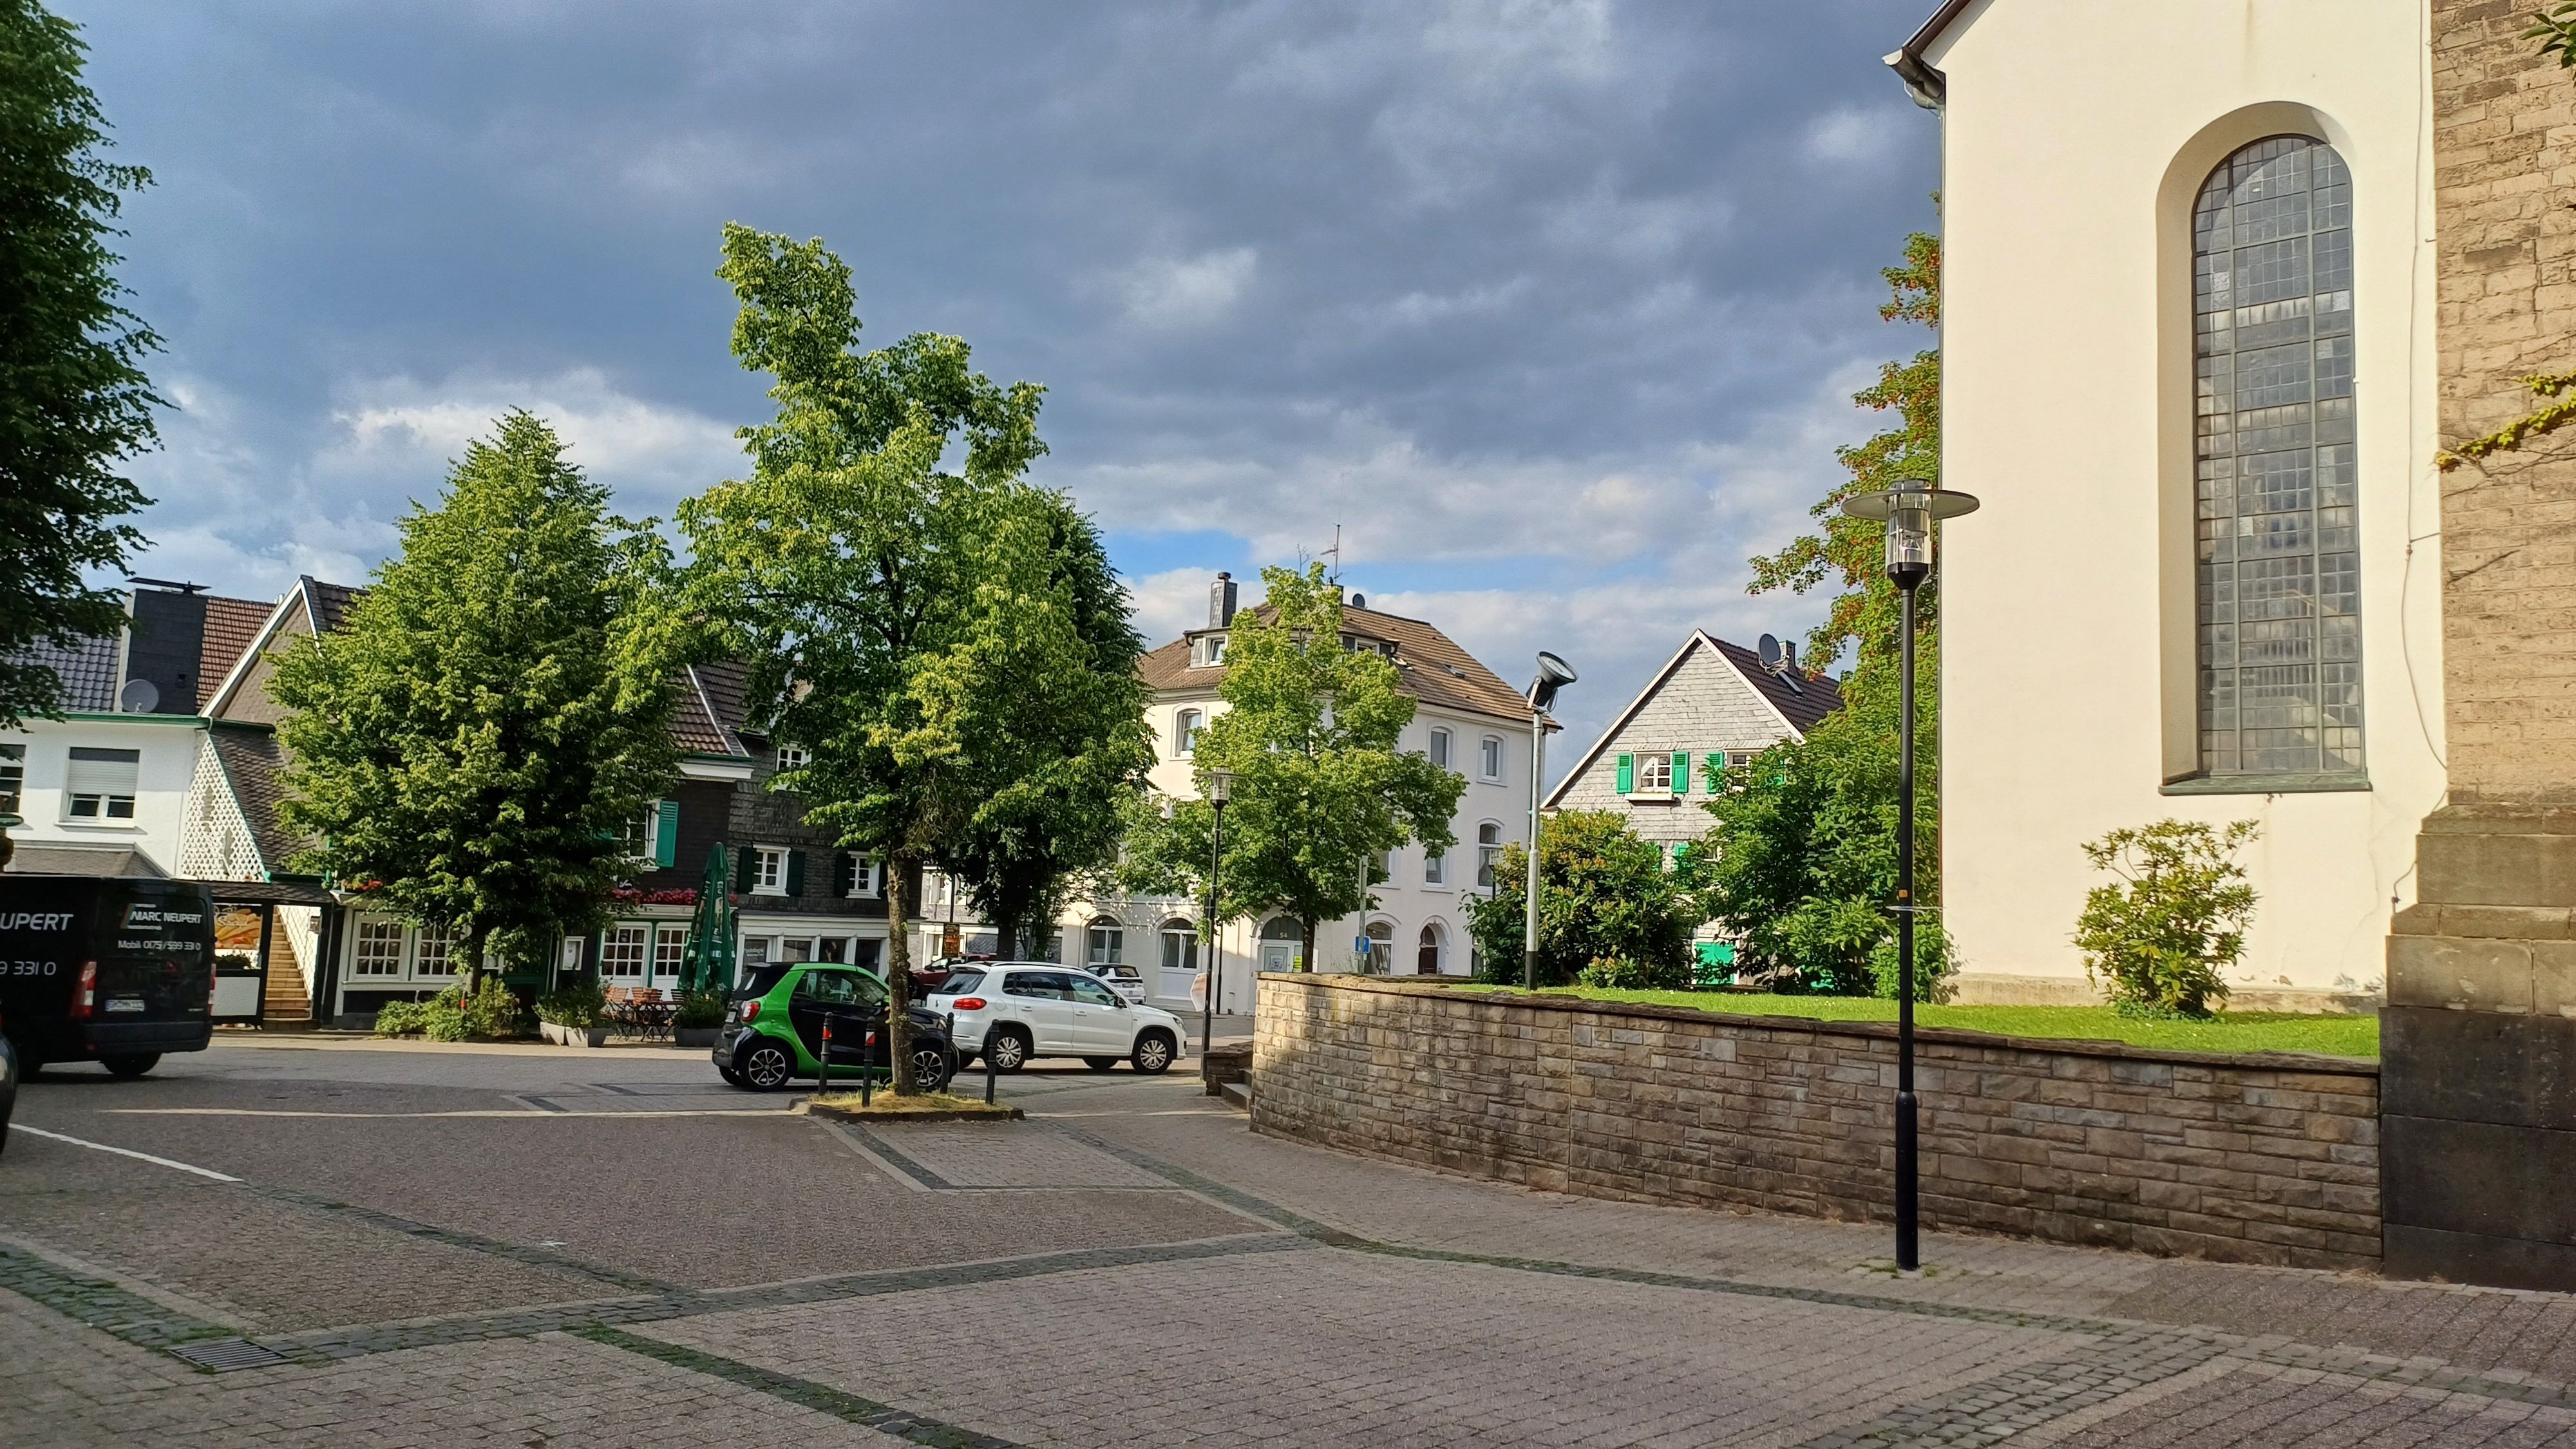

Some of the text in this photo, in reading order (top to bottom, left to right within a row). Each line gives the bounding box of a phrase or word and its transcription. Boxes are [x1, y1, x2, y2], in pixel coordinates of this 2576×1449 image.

[129, 911, 162, 922] MARC
[164, 913, 202, 923] NEUPERT
[44, 961, 56, 975] 0
